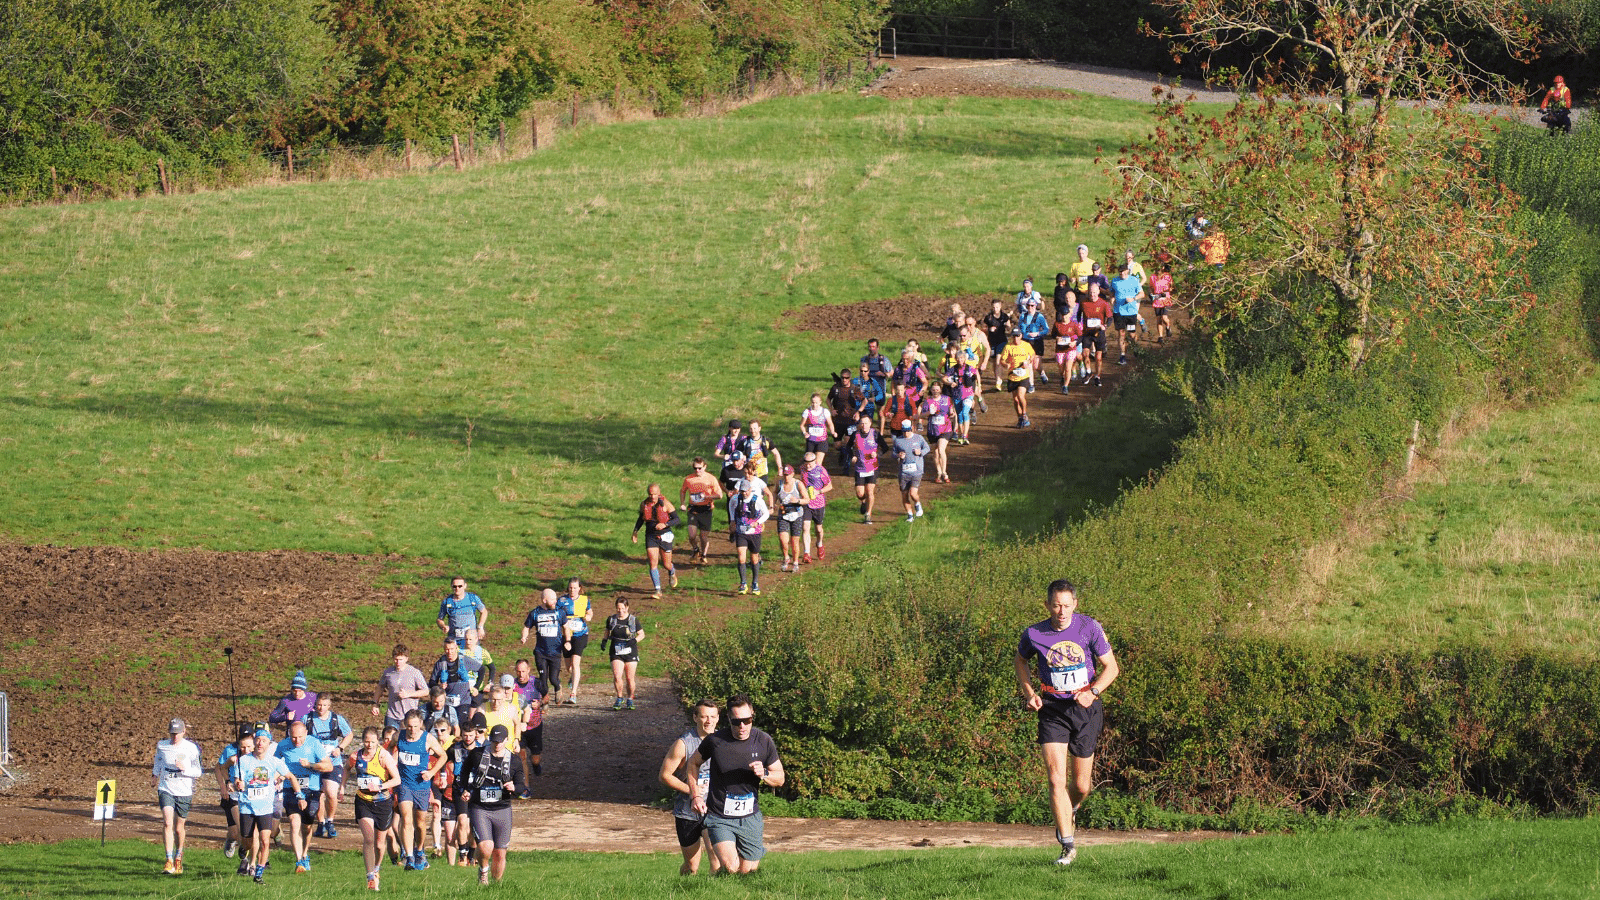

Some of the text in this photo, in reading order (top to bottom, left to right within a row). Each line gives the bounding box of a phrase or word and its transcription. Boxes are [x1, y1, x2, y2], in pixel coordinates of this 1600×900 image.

[1062, 672, 1076, 685] 71
[486, 791, 496, 799] 68
[734, 801, 746, 811] 21
